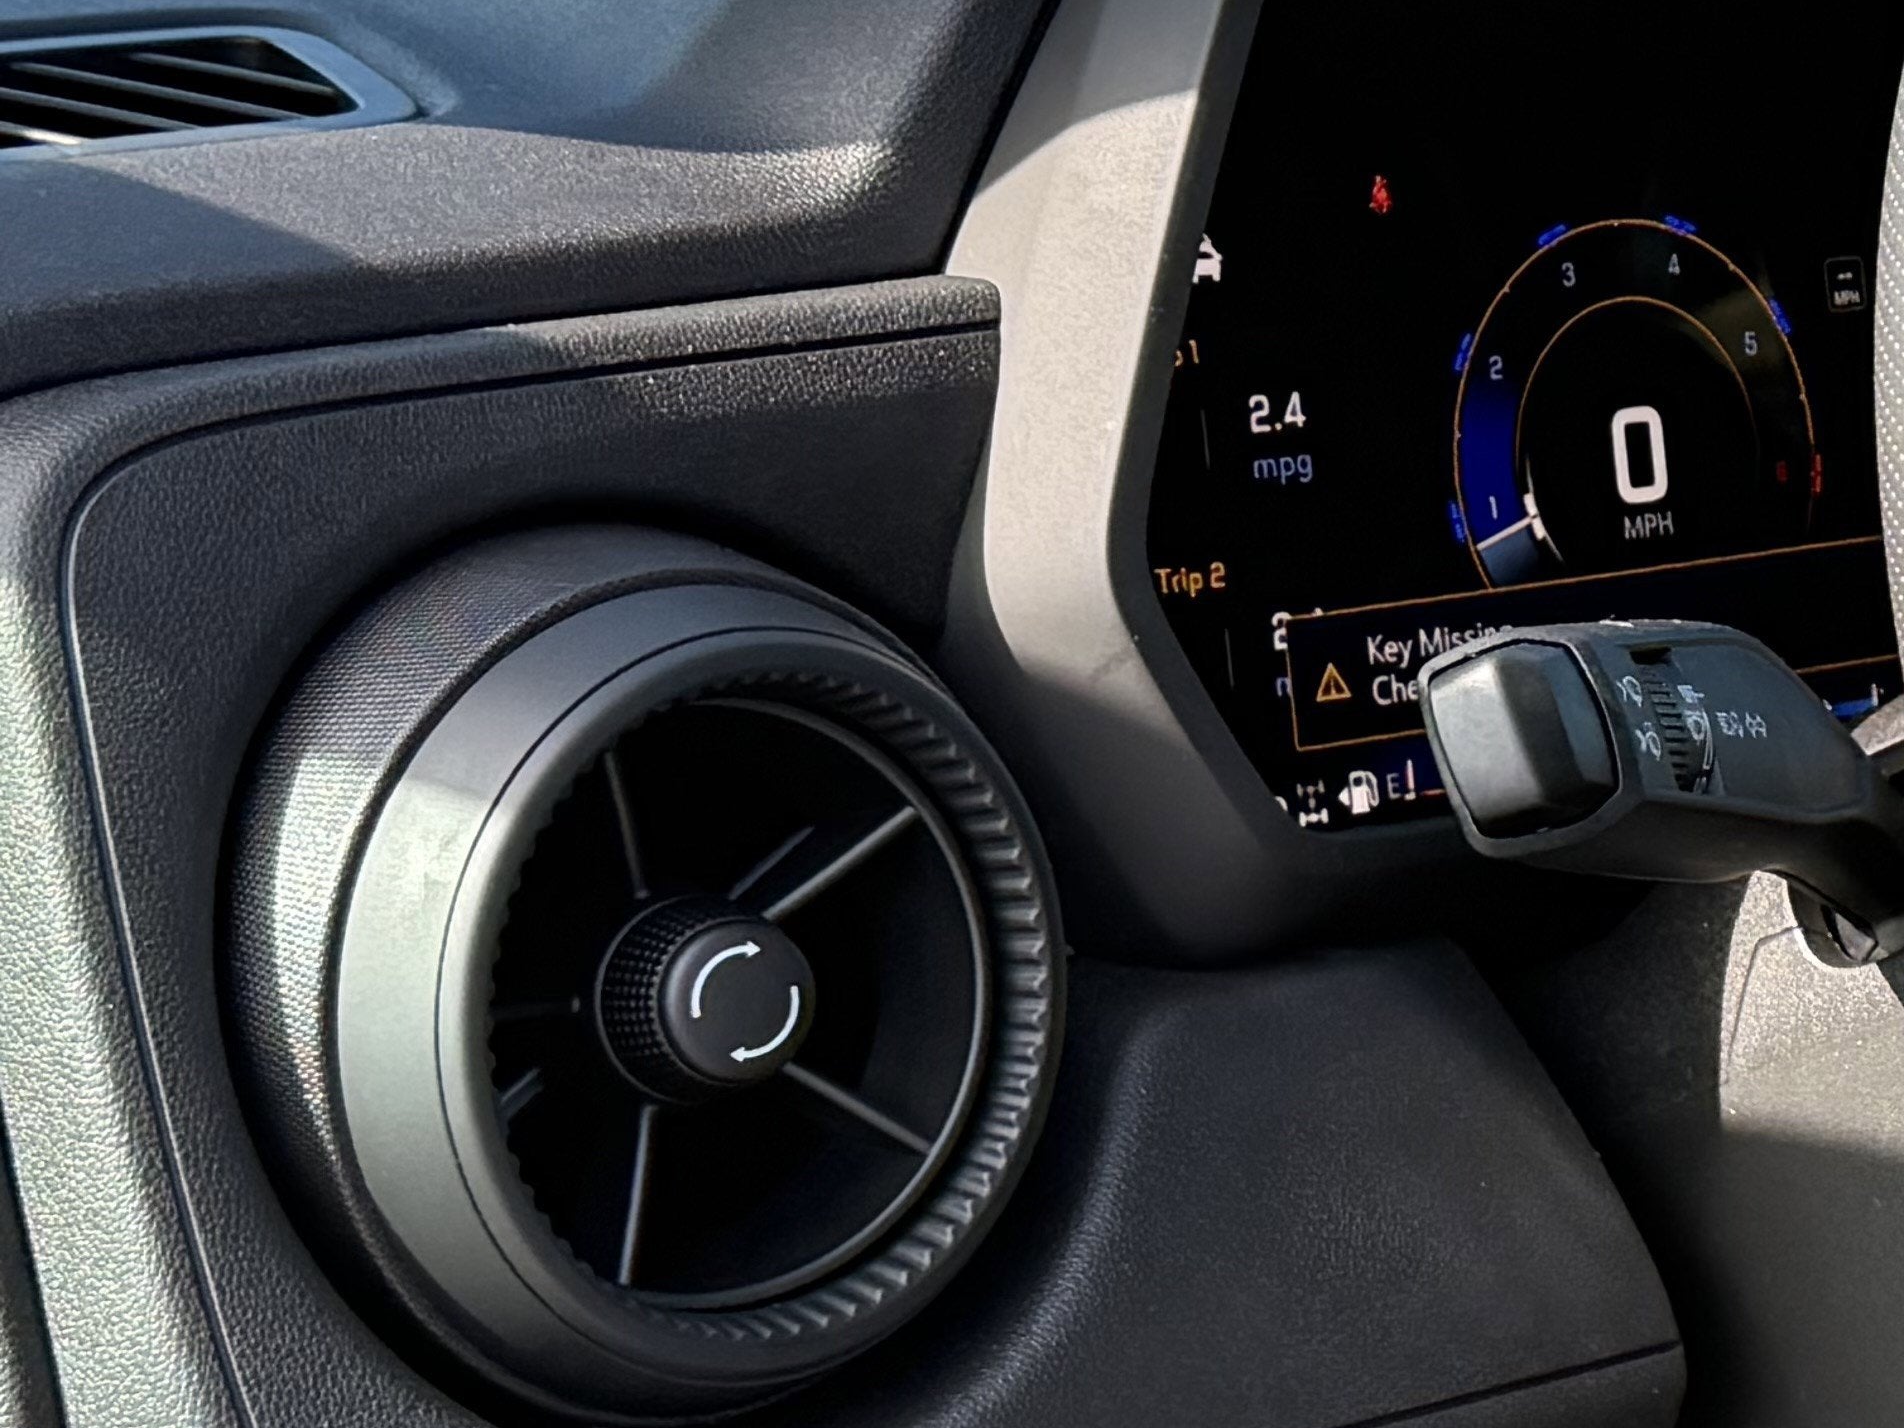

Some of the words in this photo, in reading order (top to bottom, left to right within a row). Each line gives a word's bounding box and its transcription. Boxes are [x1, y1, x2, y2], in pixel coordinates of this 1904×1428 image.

[1560, 261, 1577, 287] 3
[1667, 253, 1681, 276] 4
[1743, 331, 1759, 356] 5
[1488, 355, 1504, 380] 2
[1248, 391, 1307, 434] 2.4
[1611, 405, 1669, 504] 0
[1253, 454, 1314, 486] mpg
[1488, 495, 1499, 520] 1
[1623, 511, 1675, 540] MPH
[1153, 566, 1205, 598] Trip
[1209, 561, 1227, 590] 2
[1366, 633, 1414, 669] Key
[1418, 622, 1514, 658] Missi
[1386, 773, 1403, 800] E
